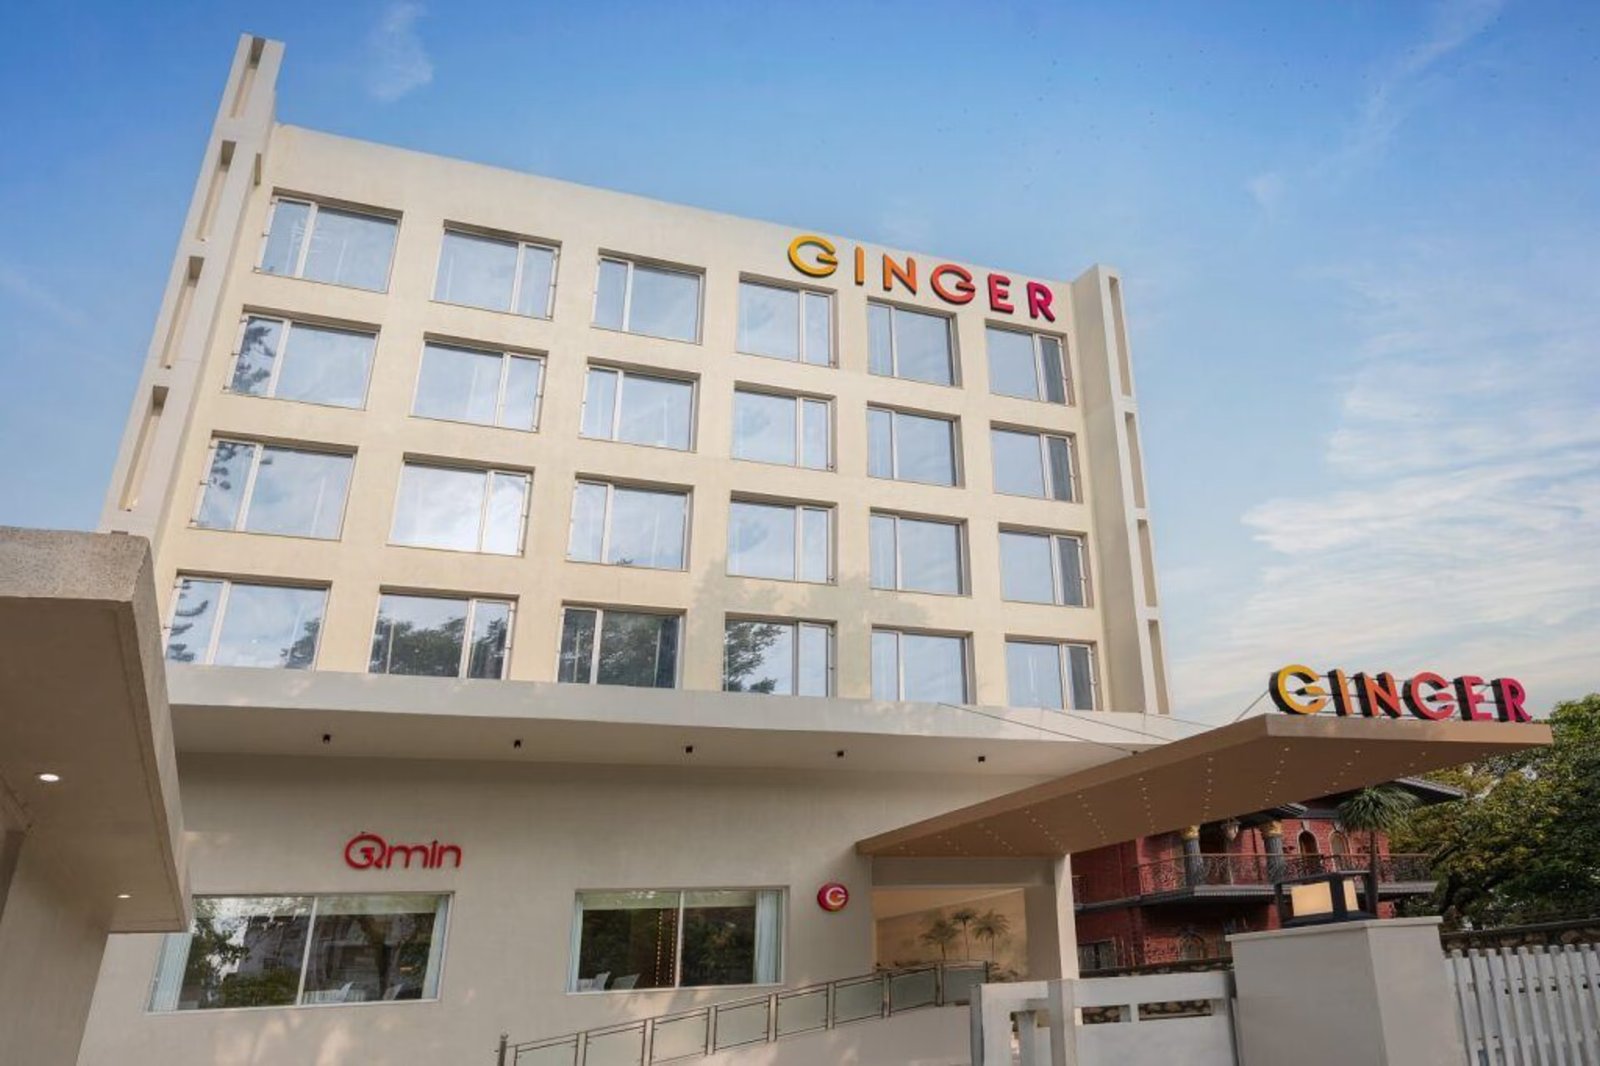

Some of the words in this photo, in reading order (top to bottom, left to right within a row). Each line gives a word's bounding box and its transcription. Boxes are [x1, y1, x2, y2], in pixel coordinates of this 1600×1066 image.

[787, 235, 1056, 322] GINGER
[1269, 664, 1532, 722] GINGER
[344, 832, 462, 870] Qmin
